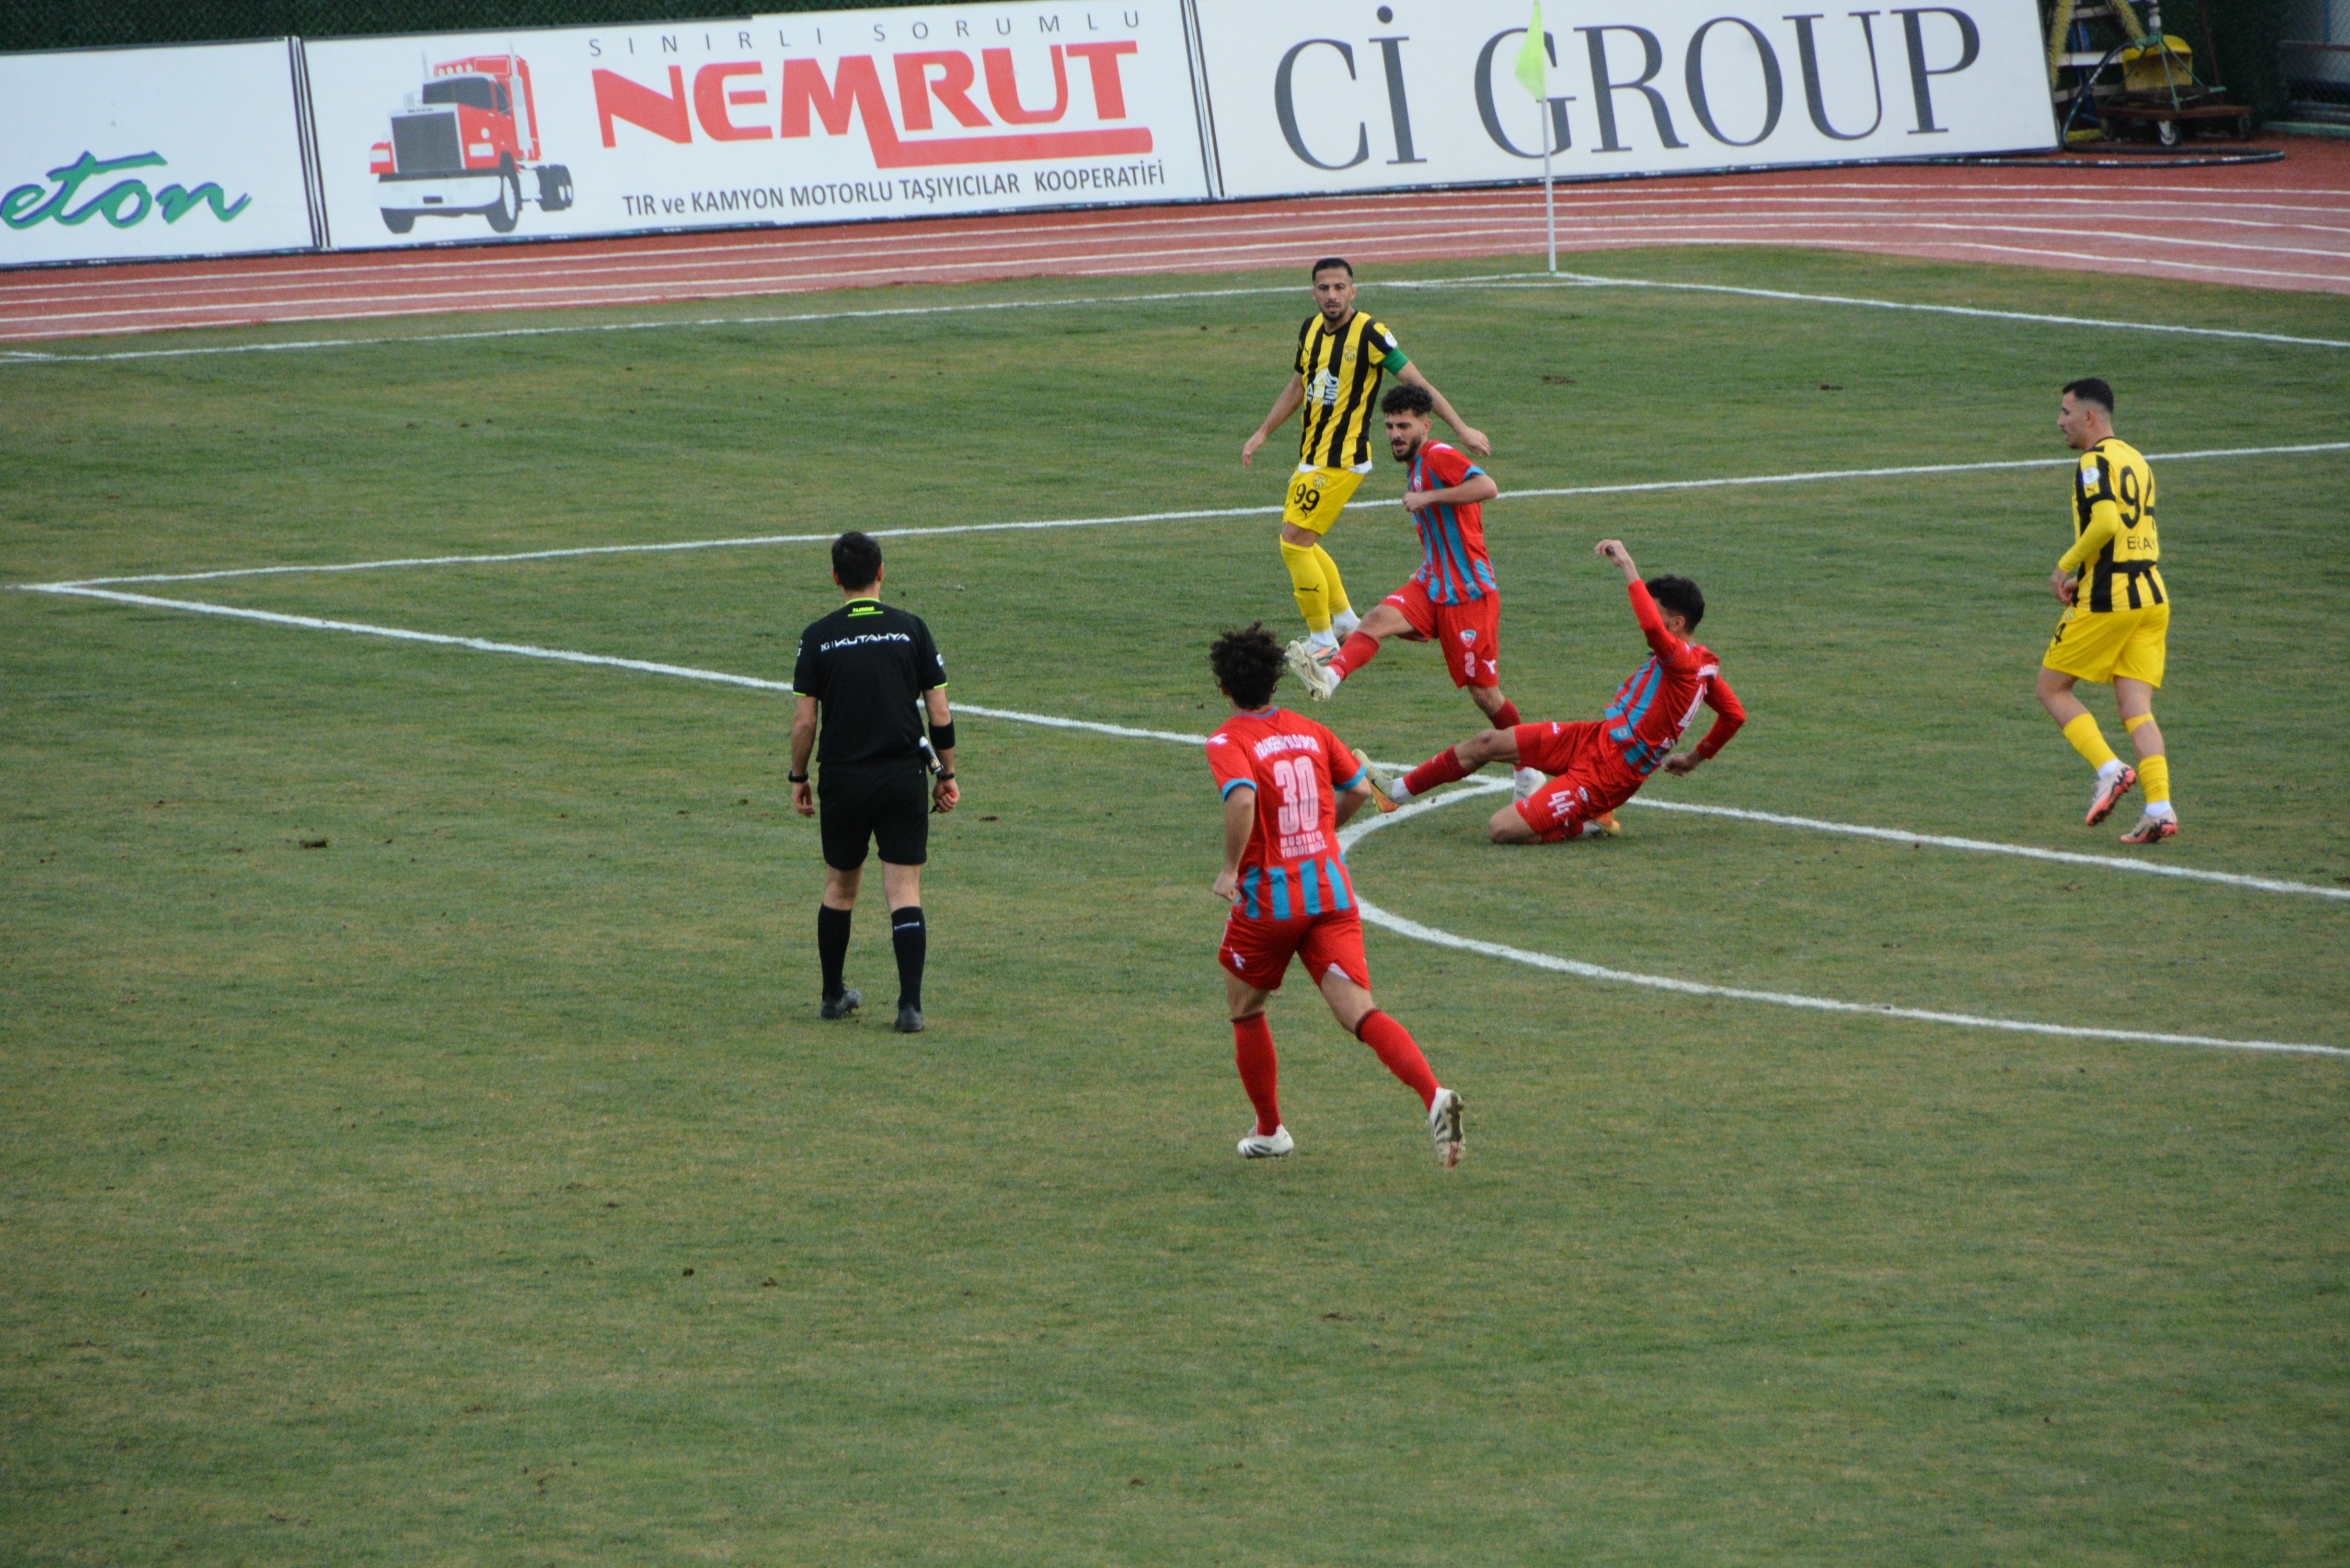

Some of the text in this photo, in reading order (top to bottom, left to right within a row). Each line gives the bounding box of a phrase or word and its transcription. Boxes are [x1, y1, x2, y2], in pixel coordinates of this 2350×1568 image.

[589, 11, 1139, 56] SINIRLI SORUMLU
[592, 40, 1139, 168] NEMRUT
[1274, 5, 1980, 170] Cİ GROUP
[623, 159, 1165, 216] TIR ve KAMYON MOTORLU TAŞIYICILAR KOOPERATİFİ
[1294, 483, 1320, 512] 99
[2119, 465, 2156, 531] 94
[1465, 651, 1476, 678] 2
[1273, 755, 1319, 835] 30
[1548, 790, 1576, 818] 44
